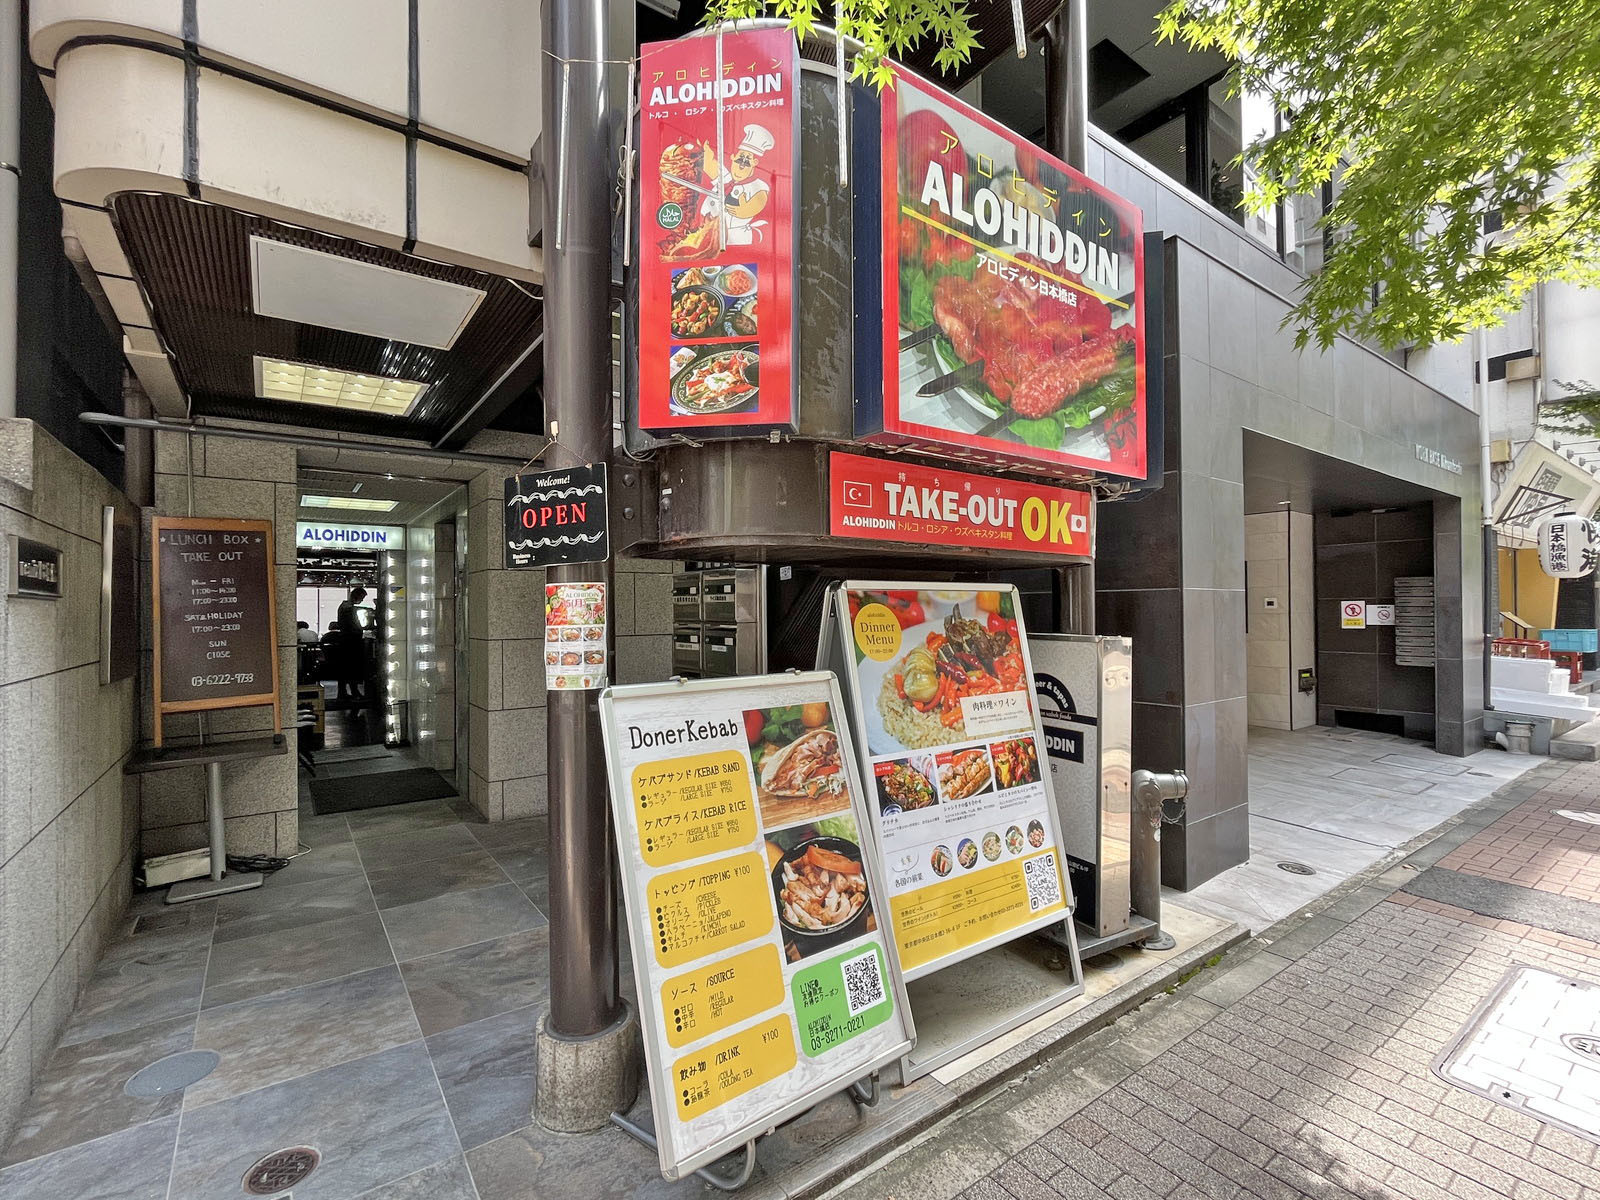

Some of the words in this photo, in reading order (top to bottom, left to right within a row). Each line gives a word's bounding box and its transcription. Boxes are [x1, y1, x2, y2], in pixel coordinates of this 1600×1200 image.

[652, 58, 783, 83] アロヒディン
[649, 72, 782, 106] ALOHIDDIN
[940, 130, 1112, 237] アロヒディン
[920, 159, 1120, 291] ALOHIDDIN
[976, 253, 1077, 307] アロヒディン日本橋店
[536, 474, 570, 488] Welcome!
[522, 502, 587, 529] OPEN
[883, 482, 1018, 528] TAKE-OUT
[1021, 496, 1073, 545] OK
[842, 515, 896, 530] ALOHIDDIN
[170, 534, 212, 546] LUNCH
[223, 534, 250, 545] BOX
[303, 528, 387, 543] ALOHIDDIN
[180, 552, 212, 563] TAKE
[218, 551, 244, 562] OUT
[860, 622, 896, 633] Dinner
[208, 640, 227, 648] SUN
[866, 634, 894, 645] Menu
[191, 673, 254, 687] 03-6222-9733
[1046, 681, 1053, 690] &
[1053, 686, 1069, 709] tapas
[972, 698, 1017, 711] 肉料理×ワイン
[628, 718, 738, 750] DonerKebab
[722, 762, 740, 773] SAND
[729, 800, 747, 813] RICE
[654, 879, 697, 900] トッピング
[734, 865, 751, 877] ¥100
[671, 982, 698, 1001] ソース
[680, 1003, 694, 1013] 甘口
[681, 1011, 695, 1022] 中辛
[683, 1019, 696, 1031] 辛口
[679, 1060, 707, 1082] 飲み物
[762, 1028, 779, 1043] ¥100
[743, 1067, 754, 1079] TEA
